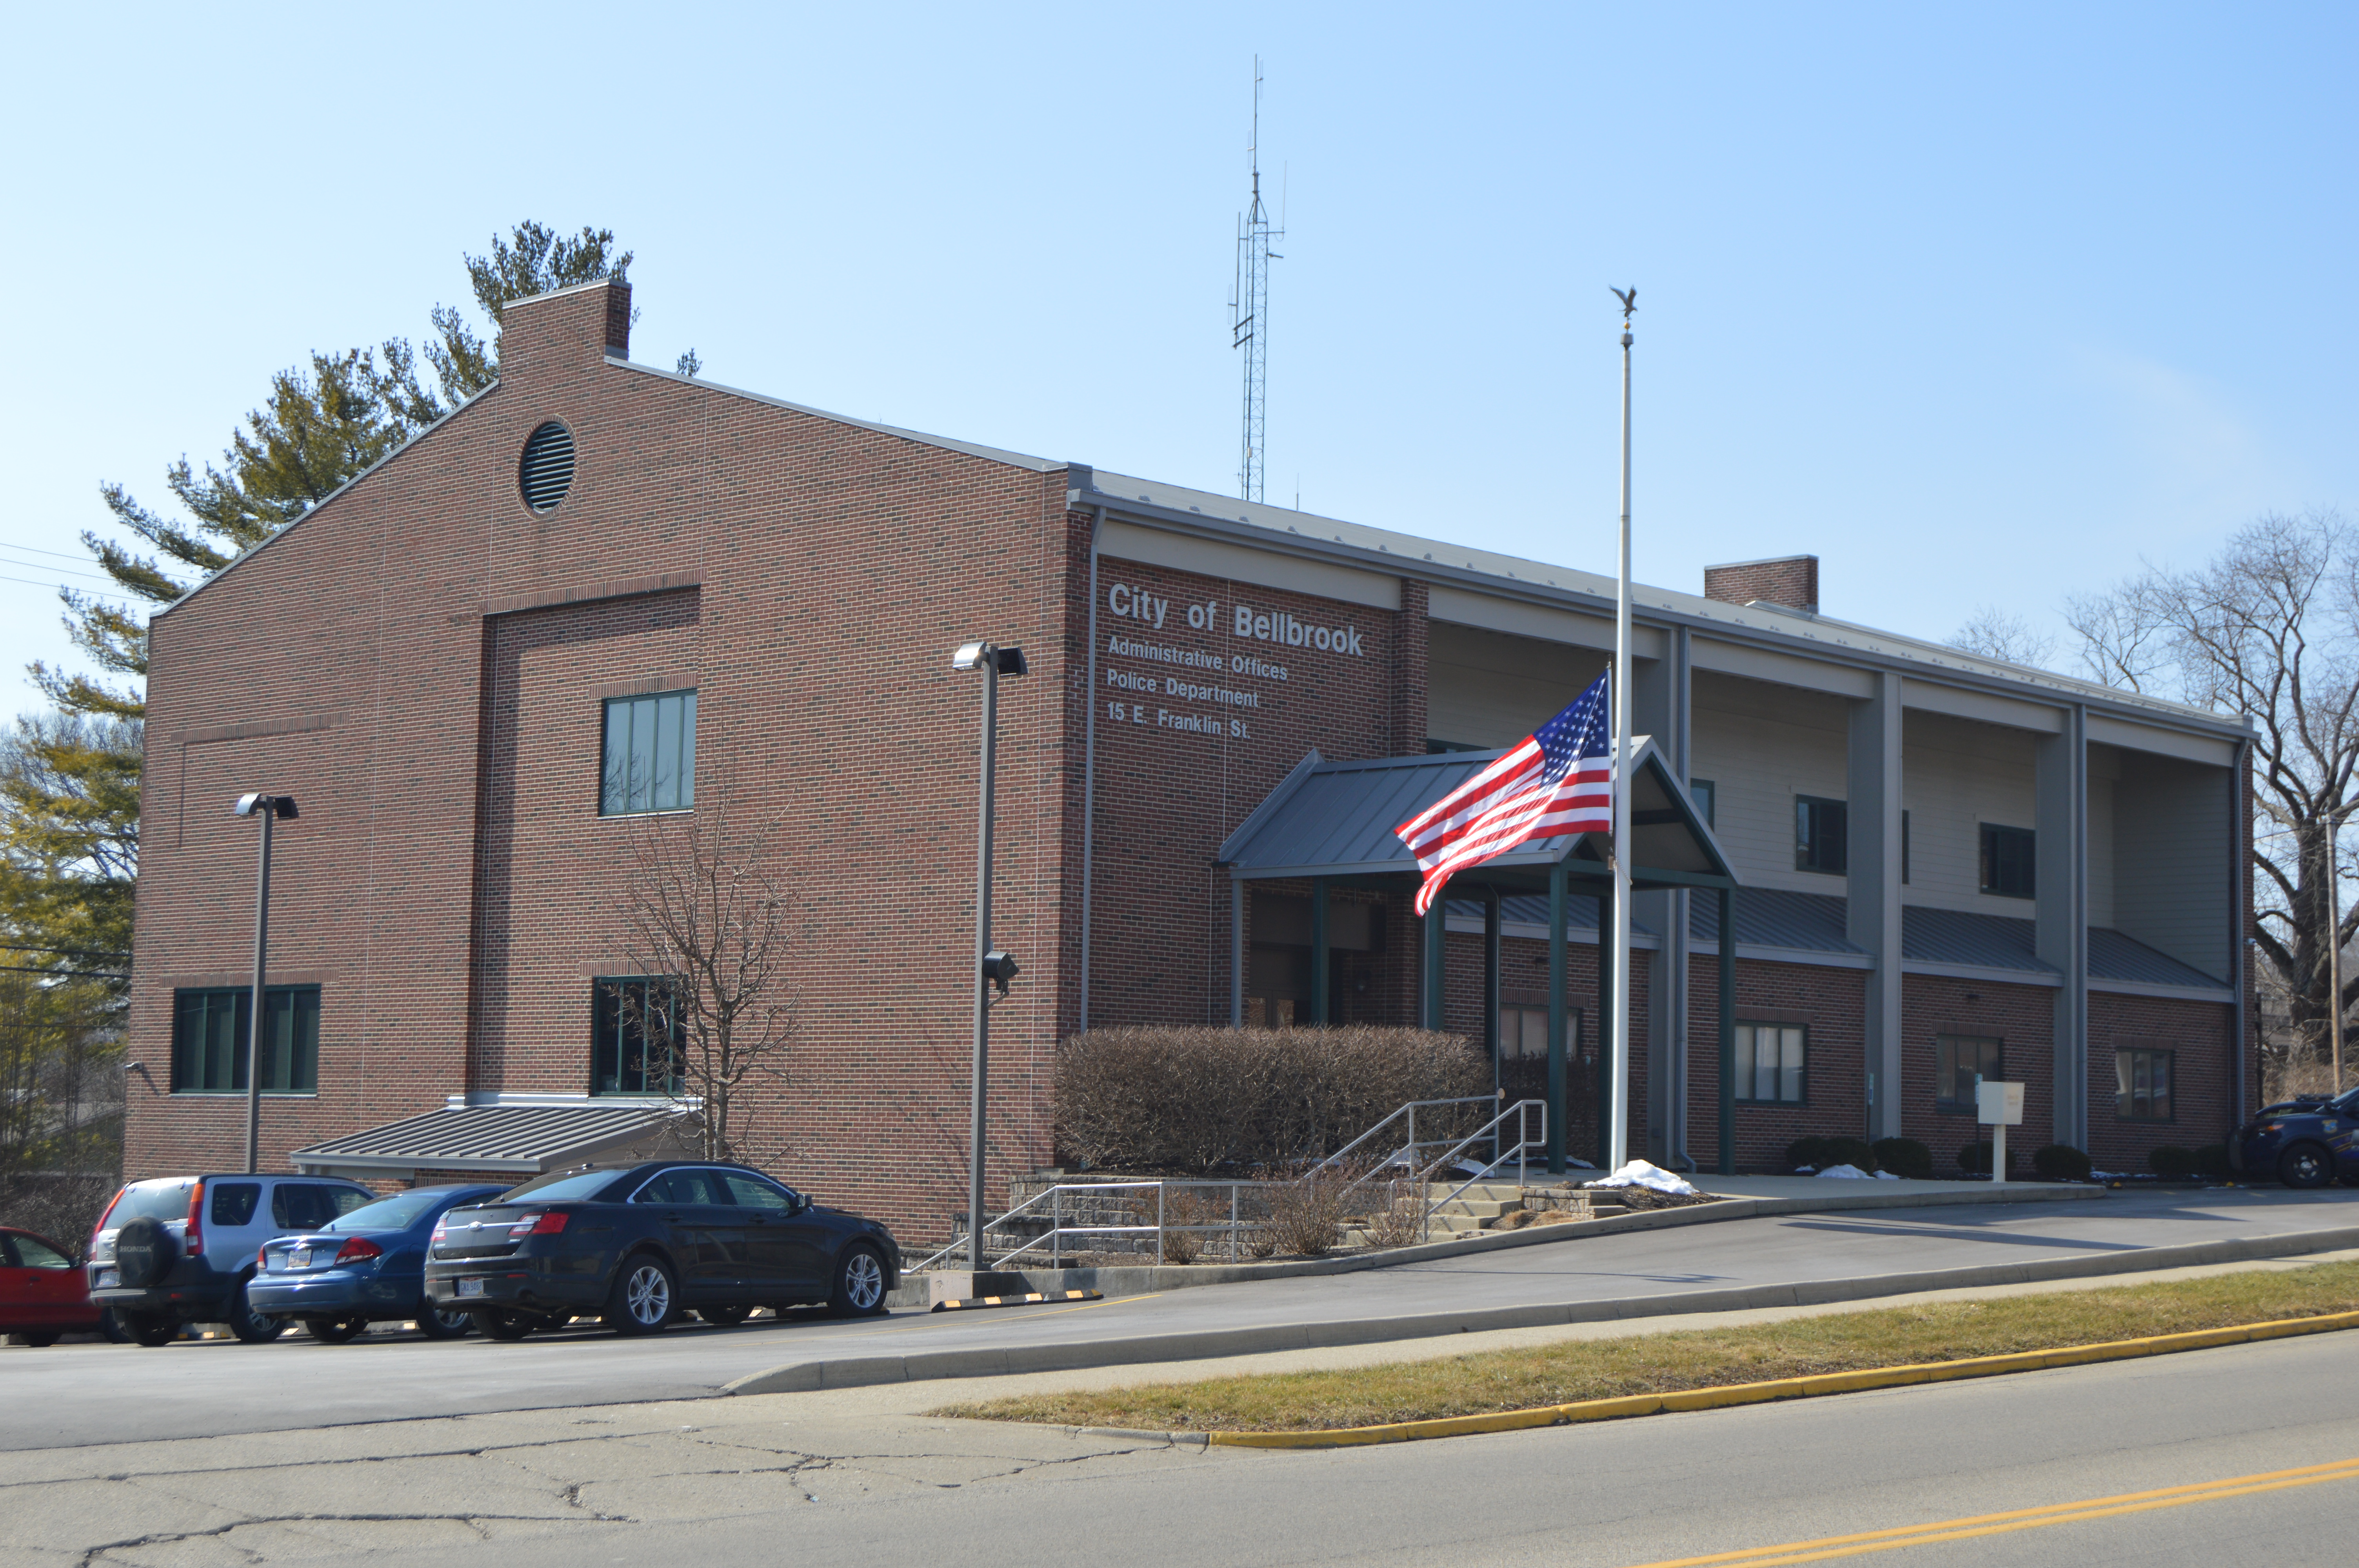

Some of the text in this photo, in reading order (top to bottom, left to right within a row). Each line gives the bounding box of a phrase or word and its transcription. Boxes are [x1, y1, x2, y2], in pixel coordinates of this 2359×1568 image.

[1109, 583, 1363, 657] City of Bellbrook
[1108, 635, 1288, 680] Administrative Offices
[1107, 668, 1259, 707] Police Department
[1107, 702, 1251, 739] 15 E. Franklin St.
